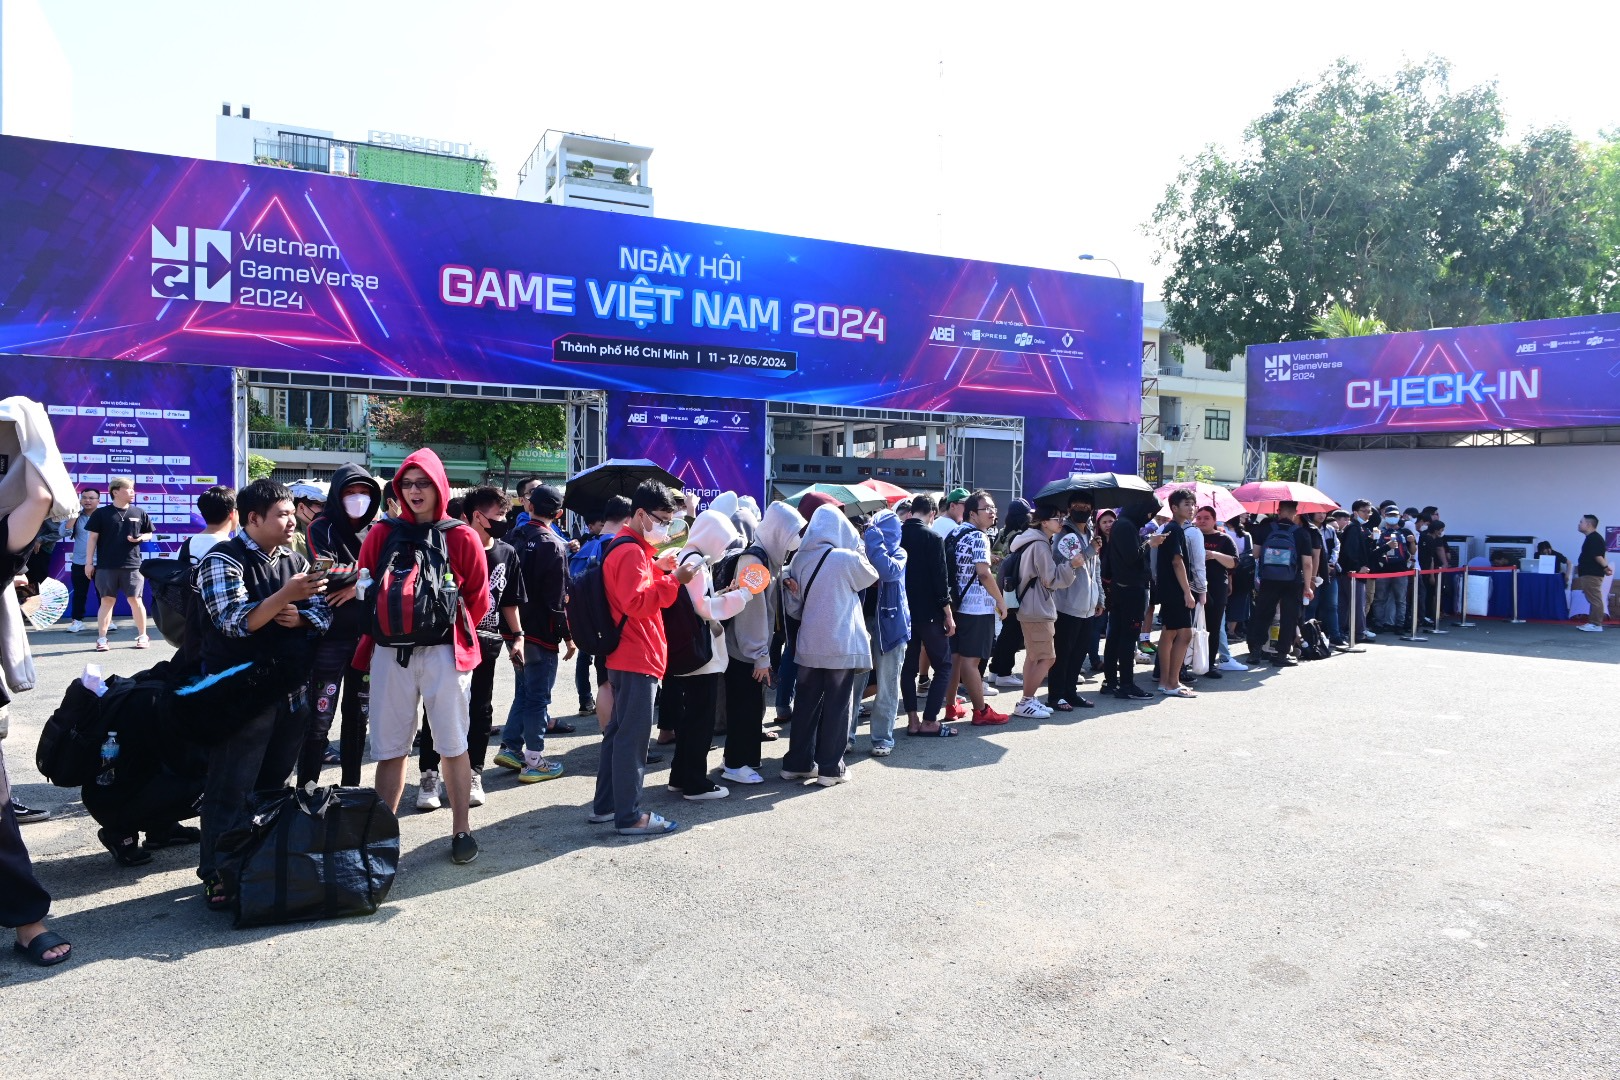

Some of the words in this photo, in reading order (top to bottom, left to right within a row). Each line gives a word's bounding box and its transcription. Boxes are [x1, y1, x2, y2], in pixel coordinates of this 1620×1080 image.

[240, 232, 340, 259] Vietnam
[240, 260, 379, 290] GameVerse
[620, 245, 691, 275] NGÀY
[700, 253, 741, 285] HỘI
[240, 287, 303, 309] 2024
[442, 267, 573, 313] GAME
[588, 277, 681, 326] VIỆT
[694, 292, 779, 331] NAM
[793, 303, 884, 342] 2024
[561, 341, 597, 354] Thành
[600, 344, 622, 357] phố
[624, 345, 641, 357] Hồ
[642, 346, 661, 359] Chí
[664, 348, 689, 361] Minh
[708, 352, 718, 363] 11
[728, 353, 787, 368] 12/05/2024
[1292, 352, 1329, 361] Vietnam
[1292, 361, 1343, 371] GameVerse
[1292, 372, 1315, 381] 2024
[1347, 369, 1539, 408] CHECK-IN
[681, 486, 722, 497] ietnam
